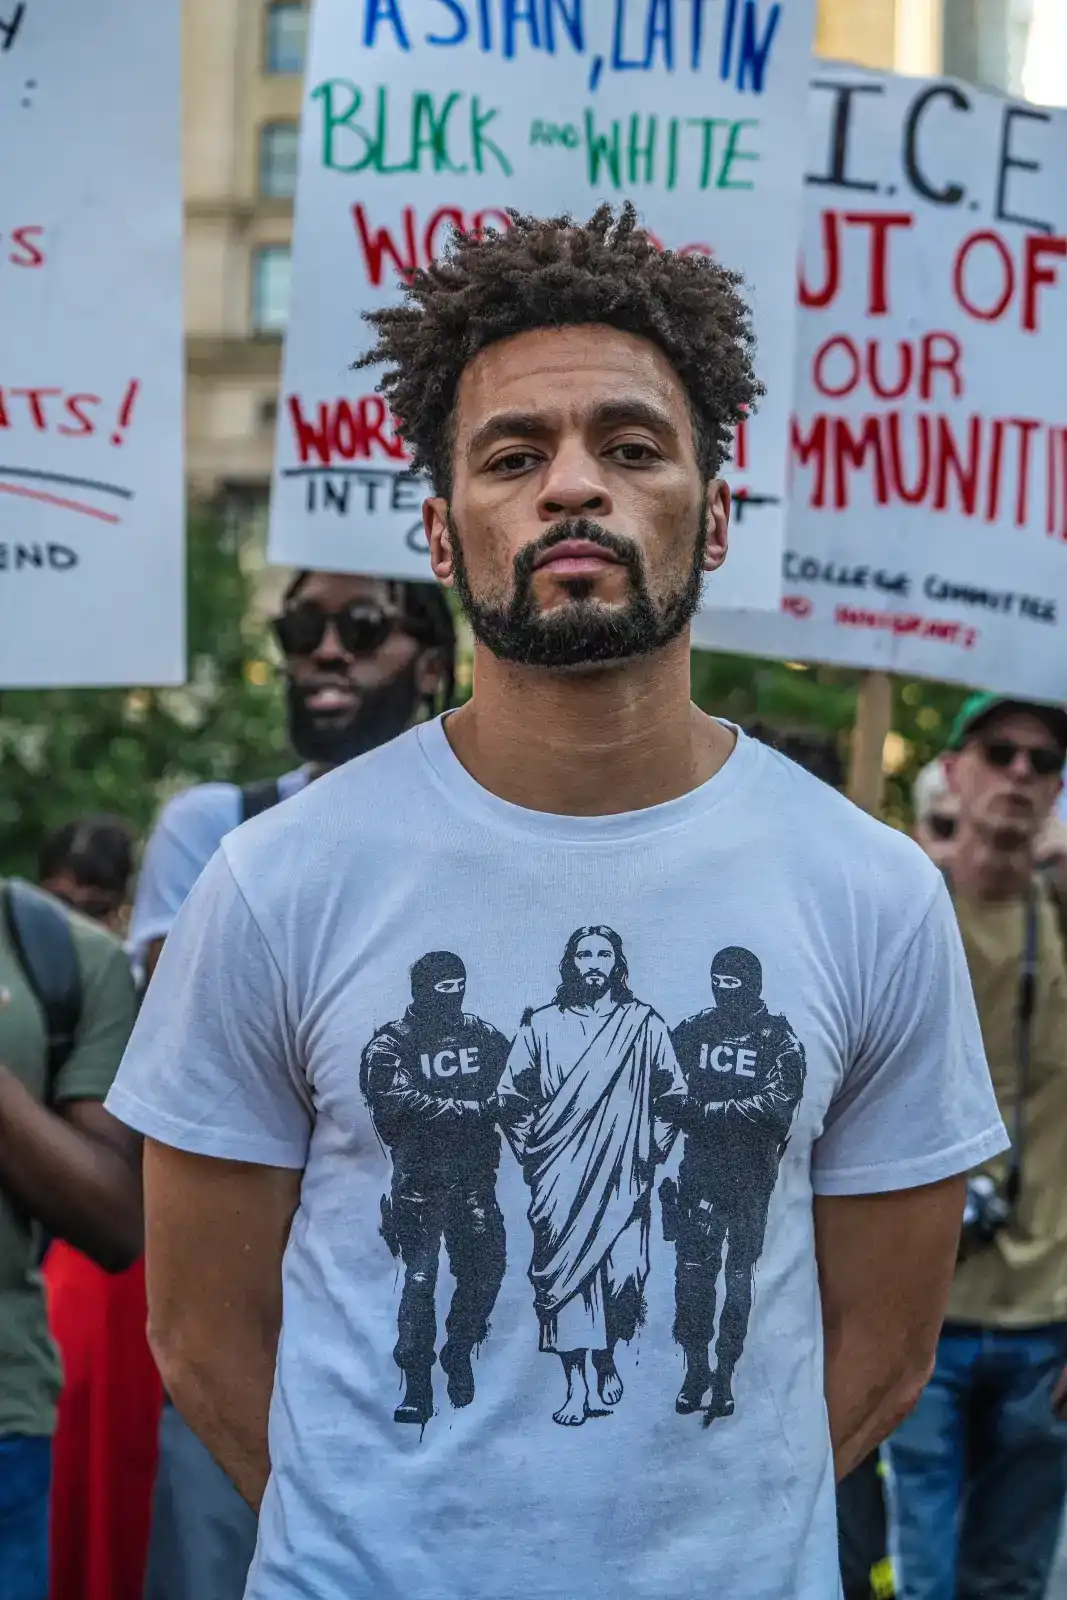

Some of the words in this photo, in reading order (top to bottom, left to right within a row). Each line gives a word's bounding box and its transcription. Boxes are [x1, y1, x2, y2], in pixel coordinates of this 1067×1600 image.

[611, 0, 781, 95] LATIN
[312, 78, 514, 176] BLACK
[585, 105, 762, 192] WHITE
[954, 229, 1067, 334] OF
[813, 333, 964, 401] OUR
[420, 1047, 480, 1080] ICE
[700, 1043, 757, 1078] ICE
